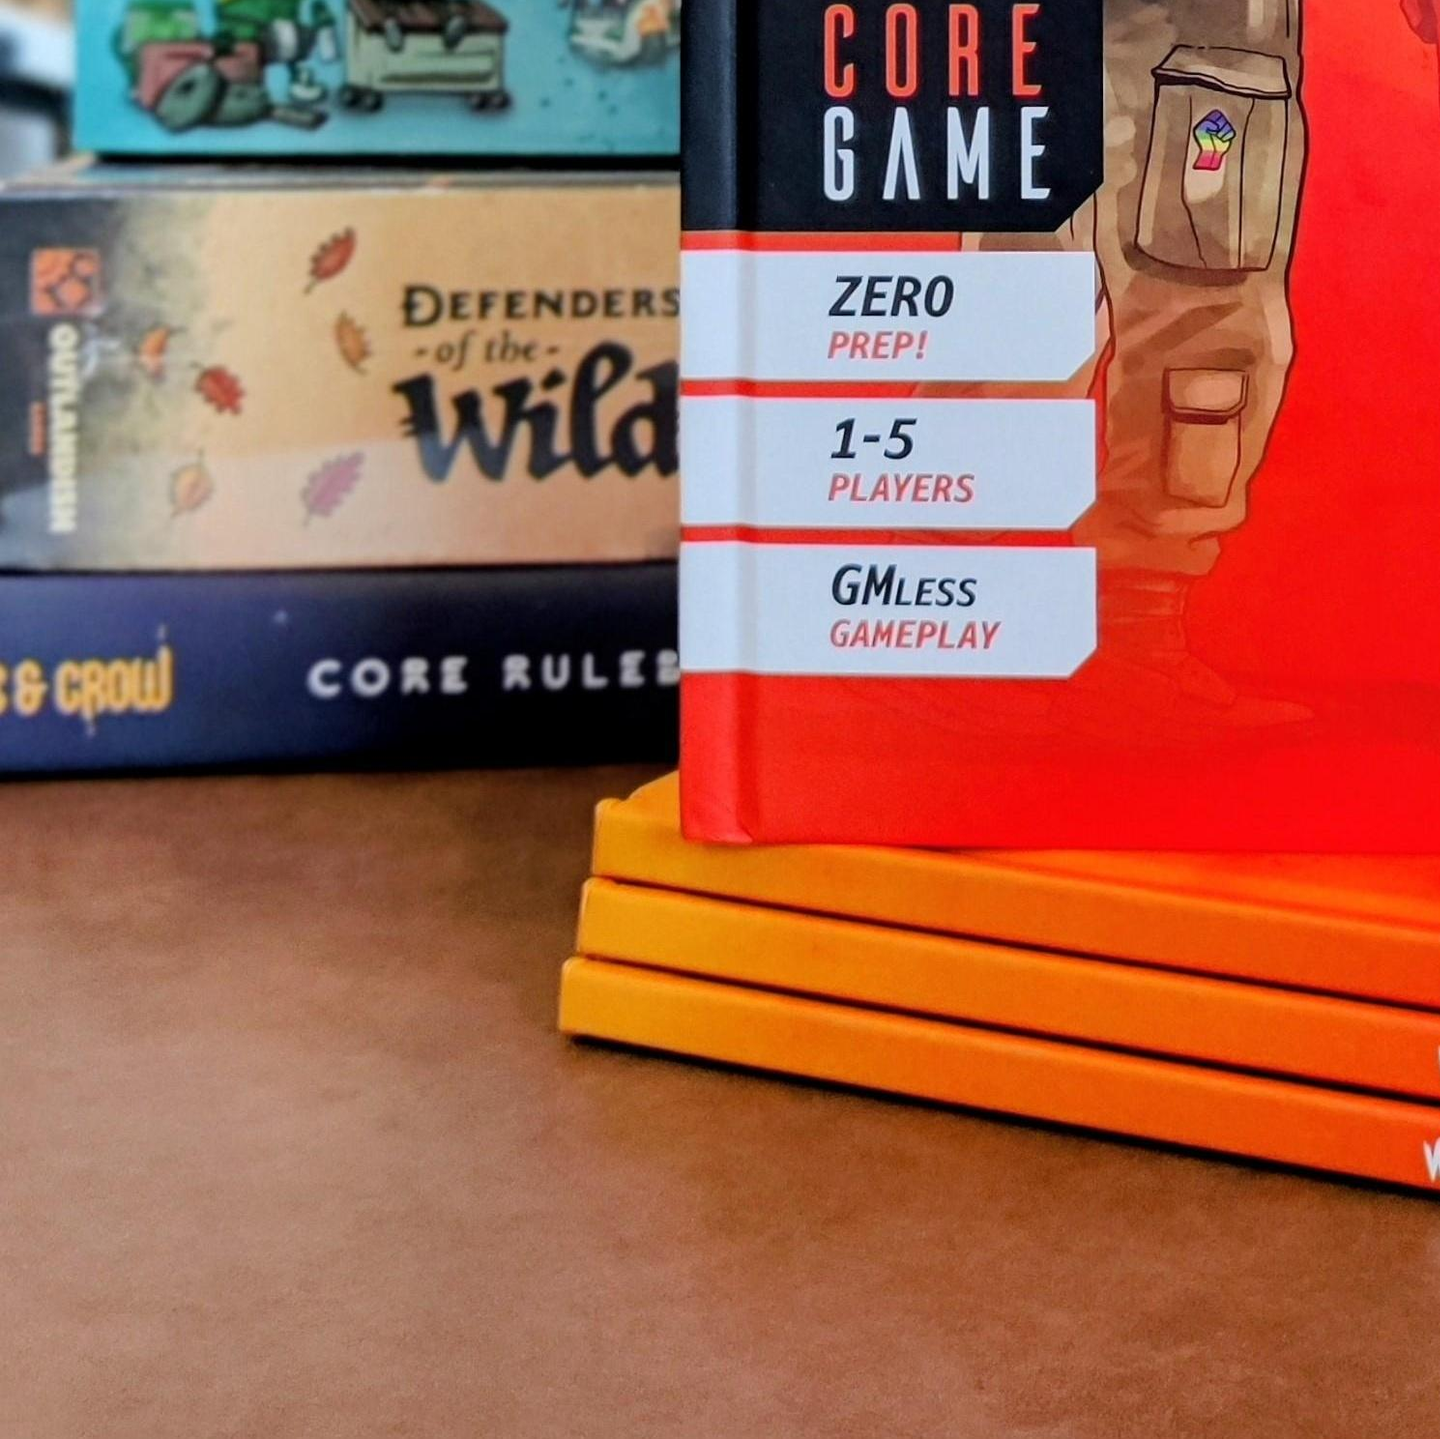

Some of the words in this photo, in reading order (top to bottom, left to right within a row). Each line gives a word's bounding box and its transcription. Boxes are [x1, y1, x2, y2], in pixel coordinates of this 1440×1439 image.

[824, 3, 1042, 98] CORE
[824, 106, 1051, 201] GAME
[828, 275, 954, 317] ZERO
[827, 330, 929, 359] PREP!
[391, 340, 679, 482] Wild
[830, 417, 917, 460] 1-5
[828, 473, 975, 502] PLAYERS
[829, 619, 1001, 650] GAMEPLAY
[307, 658, 468, 698] CORE
